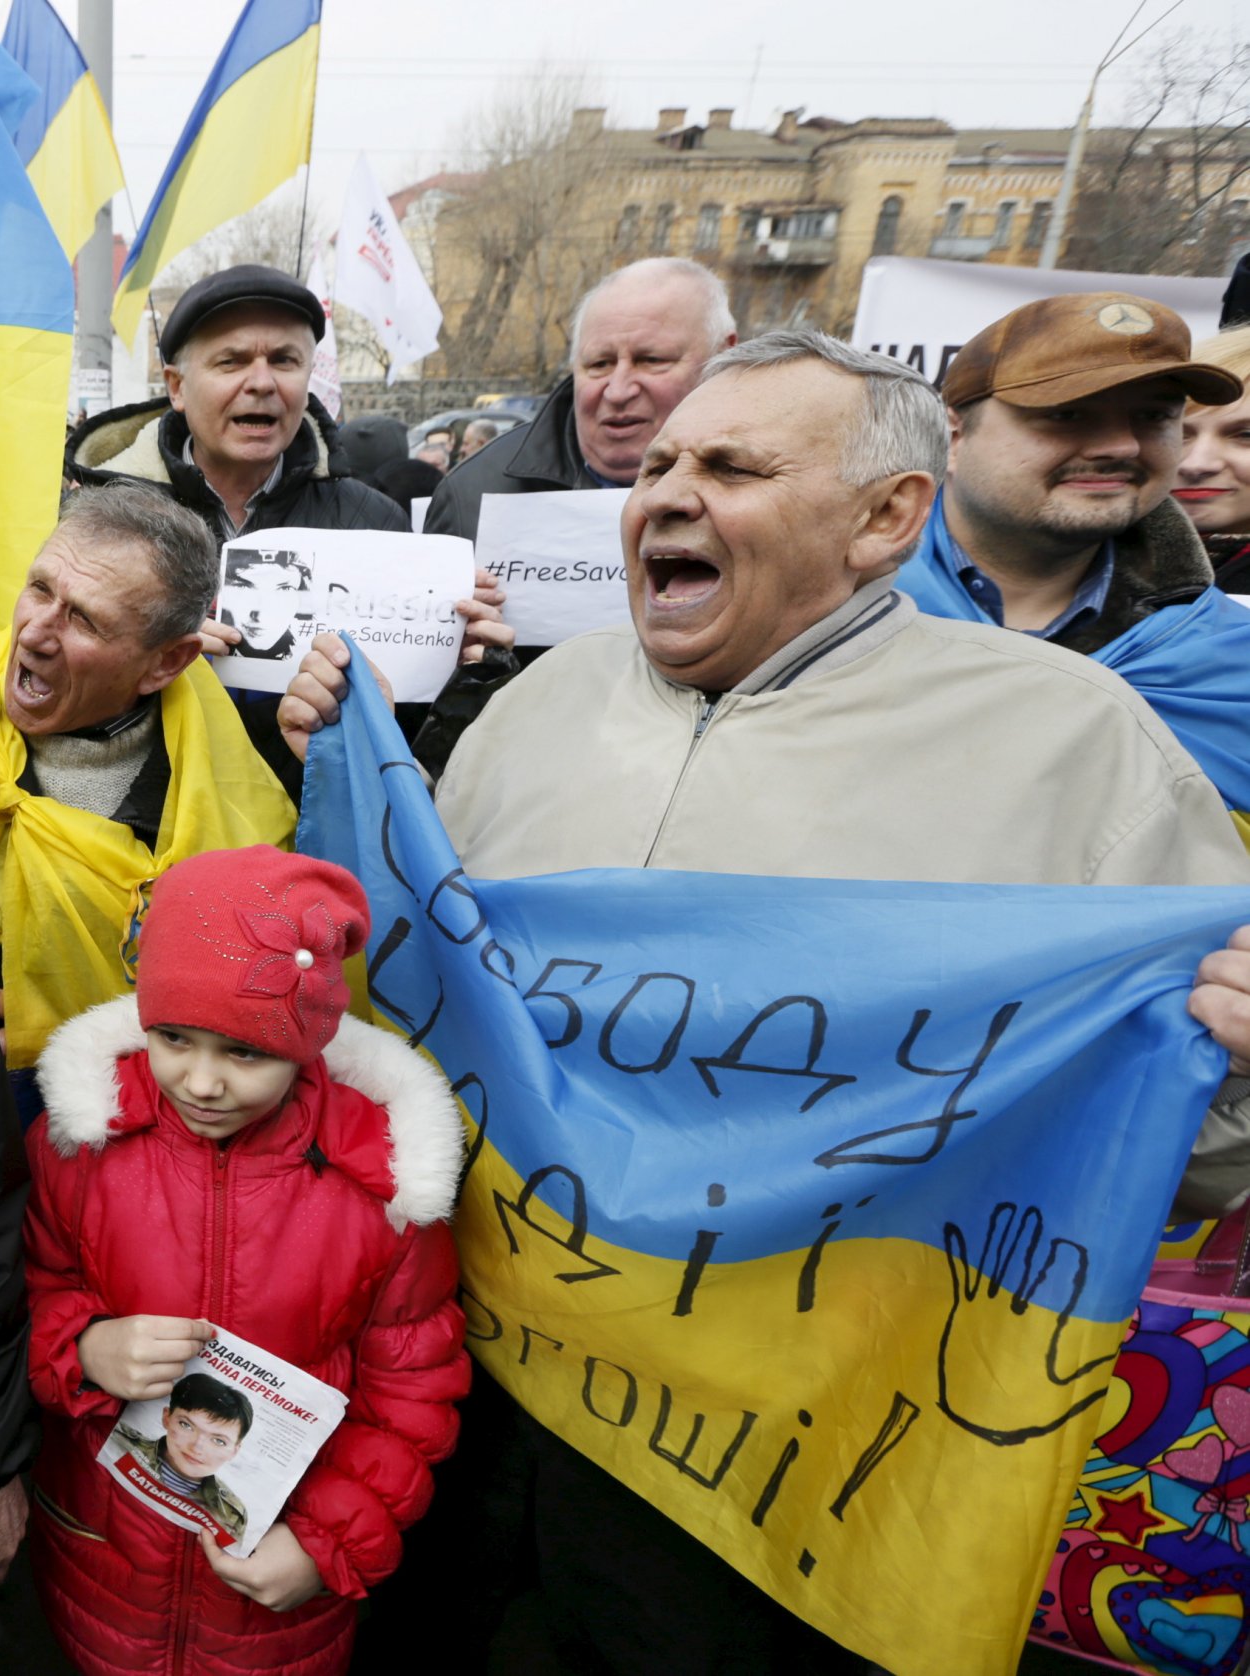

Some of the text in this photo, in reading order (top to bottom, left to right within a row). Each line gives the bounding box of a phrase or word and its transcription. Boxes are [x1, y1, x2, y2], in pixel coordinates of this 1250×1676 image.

[325, 582, 457, 625] Russia
[298, 621, 455, 648] #FeSavchenko
[208, 1339, 285, 1390] ЗДАВАТИСЬ!
[240, 1376, 319, 1424] ПЕРЕМОЖЕ!
